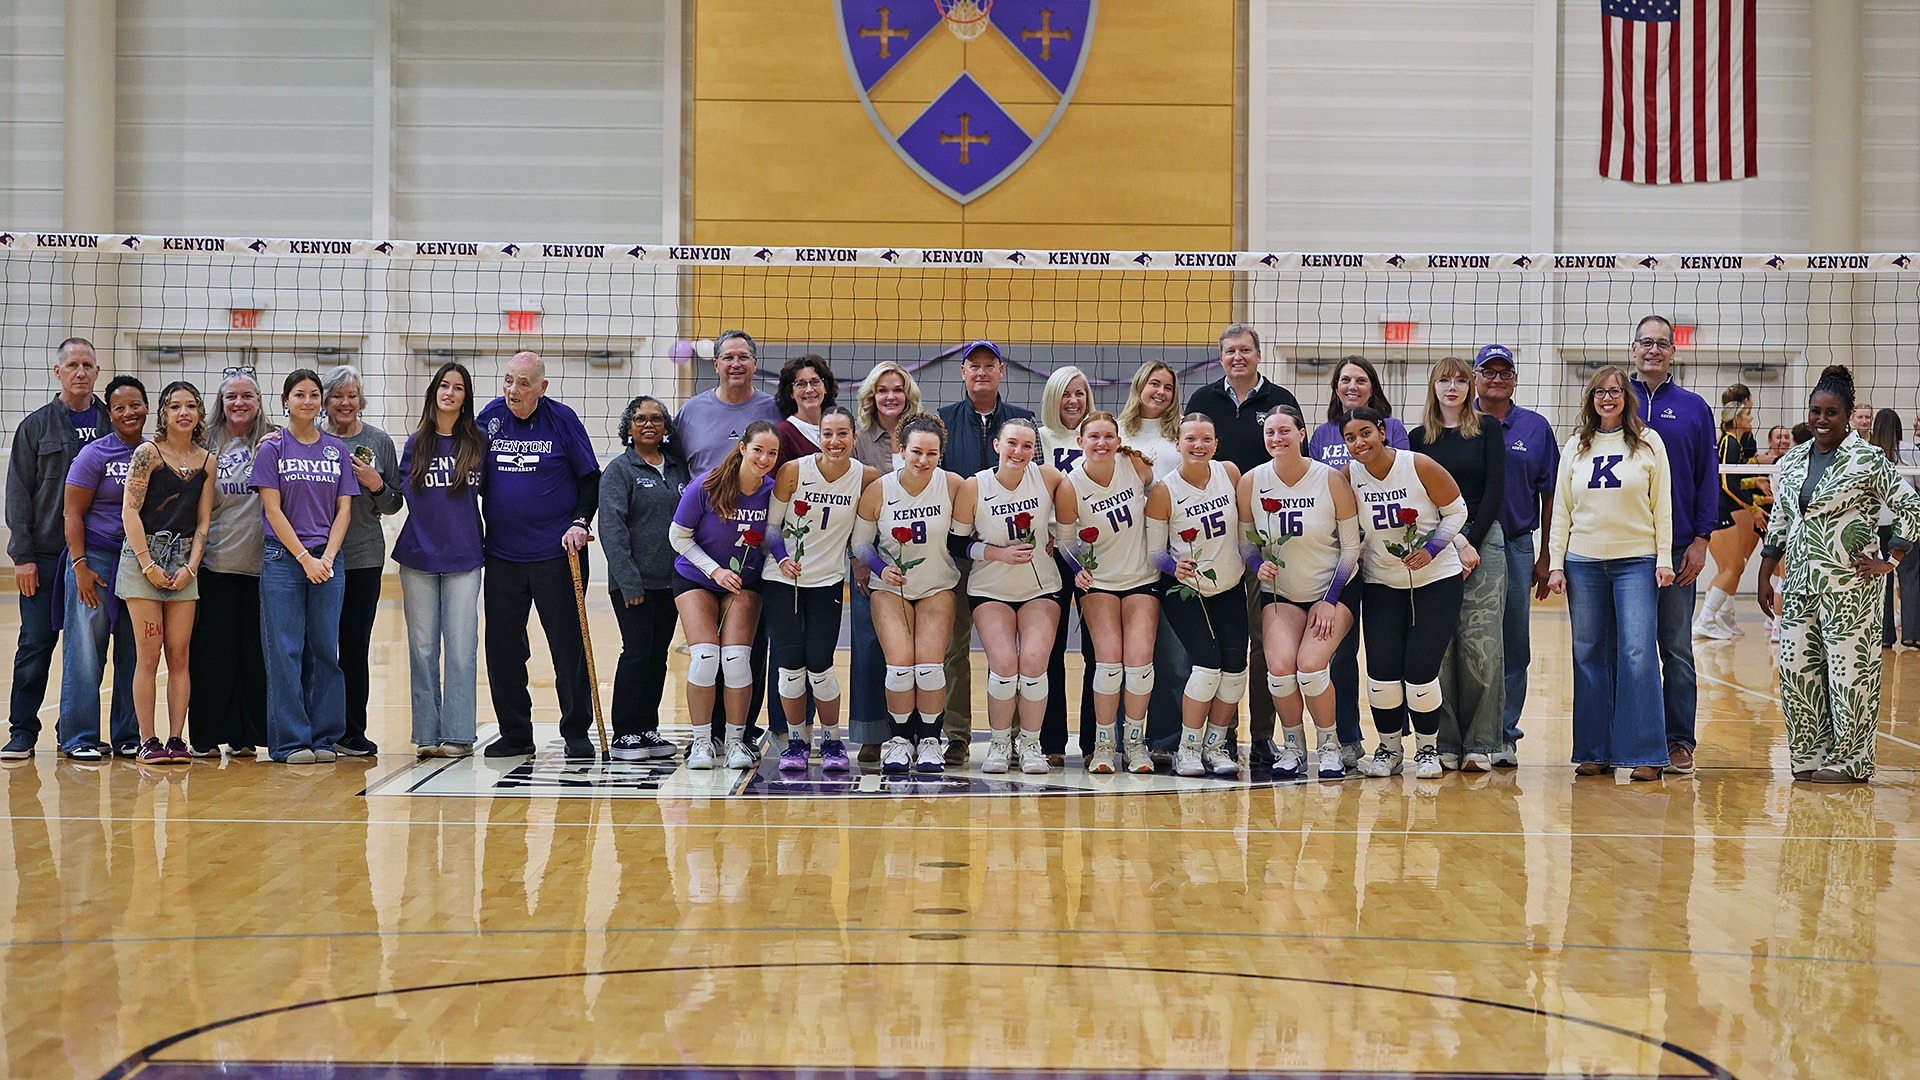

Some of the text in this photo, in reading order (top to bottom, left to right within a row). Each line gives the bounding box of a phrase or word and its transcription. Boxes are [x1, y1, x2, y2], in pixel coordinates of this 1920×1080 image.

[36, 234, 99, 248] KENYON
[163, 237, 225, 252] KENYON
[289, 240, 352, 255] KENYON
[416, 242, 479, 256] KENYON
[542, 244, 605, 259] KENYON
[668, 246, 732, 261] KENYON
[795, 248, 858, 262] KENYON
[921, 250, 984, 264] KENYON
[1048, 251, 1111, 265] KENYON
[1174, 253, 1238, 267] KENYON
[1301, 254, 1364, 268] KENYON
[1427, 254, 1491, 269] KENYON
[1553, 255, 1617, 269] KENYON
[1680, 256, 1743, 270] KENYON
[1806, 256, 1870, 269] KENYON
[231, 310, 258, 329] EXIT
[508, 312, 536, 331] EXIT
[1386, 323, 1411, 342] EXIT
[490, 439, 553, 454] KENYON
[1053, 447, 1084, 475] K
[497, 465, 537, 473] GRANDPARENT
[1587, 454, 1624, 489] K
[284, 473, 336, 484] VOLLEYBALL
[803, 491, 852, 506] KENYON
[1090, 487, 1136, 514] KENYON
[1363, 487, 1408, 503] KENYON
[892, 504, 942, 521] KENYON
[990, 497, 1040, 516] KENYON
[1184, 494, 1231, 518] KENYON
[820, 506, 831, 531] 1
[1105, 504, 1134, 534] 14
[1278, 510, 1304, 537] 16
[1371, 502, 1405, 531] 20
[910, 520, 928, 545] 8
[1200, 510, 1227, 541] 15
[734, 523, 752, 547] 7
